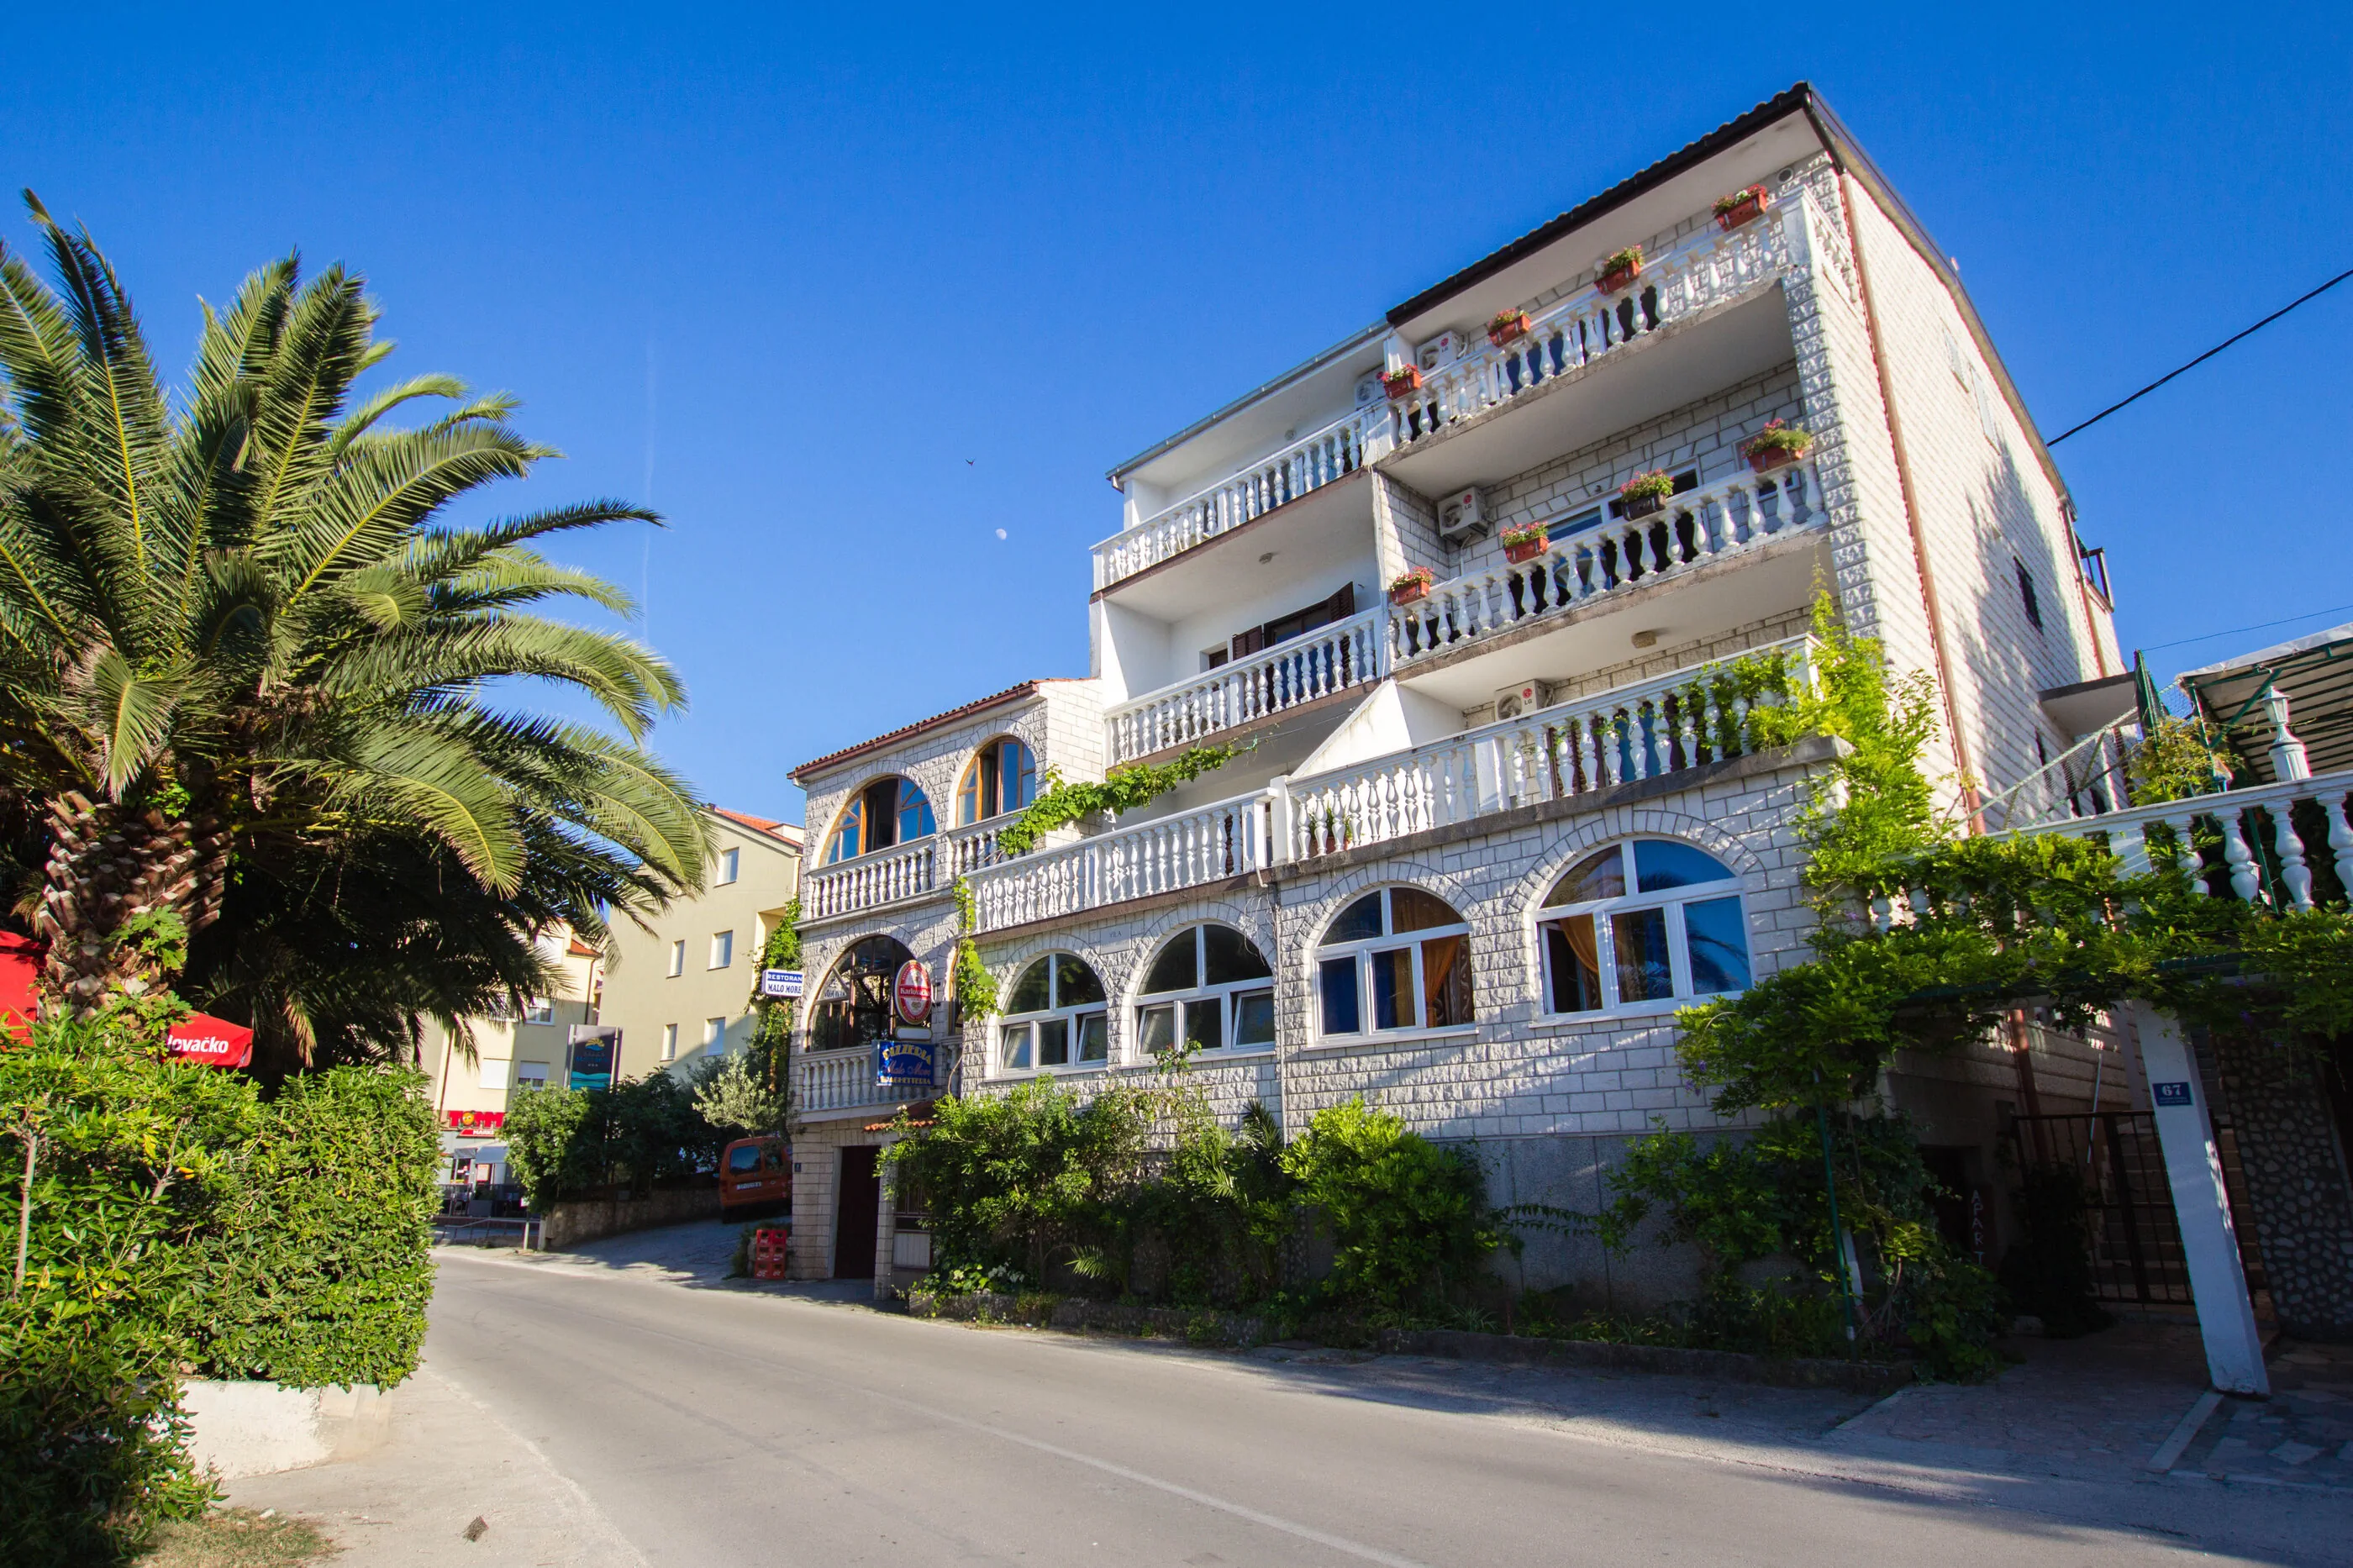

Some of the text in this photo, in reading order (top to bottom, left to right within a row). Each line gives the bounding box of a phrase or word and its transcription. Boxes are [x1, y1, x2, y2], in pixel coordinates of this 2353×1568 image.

[767, 974, 803, 982] RESTORAN
[768, 983, 802, 994] MALO MORE
[882, 1044, 931, 1066] PIZZERIA
[2161, 1084, 2182, 1096] 67
[448, 1110, 505, 1129] TOMM
[1971, 1189, 1985, 1265] APART
